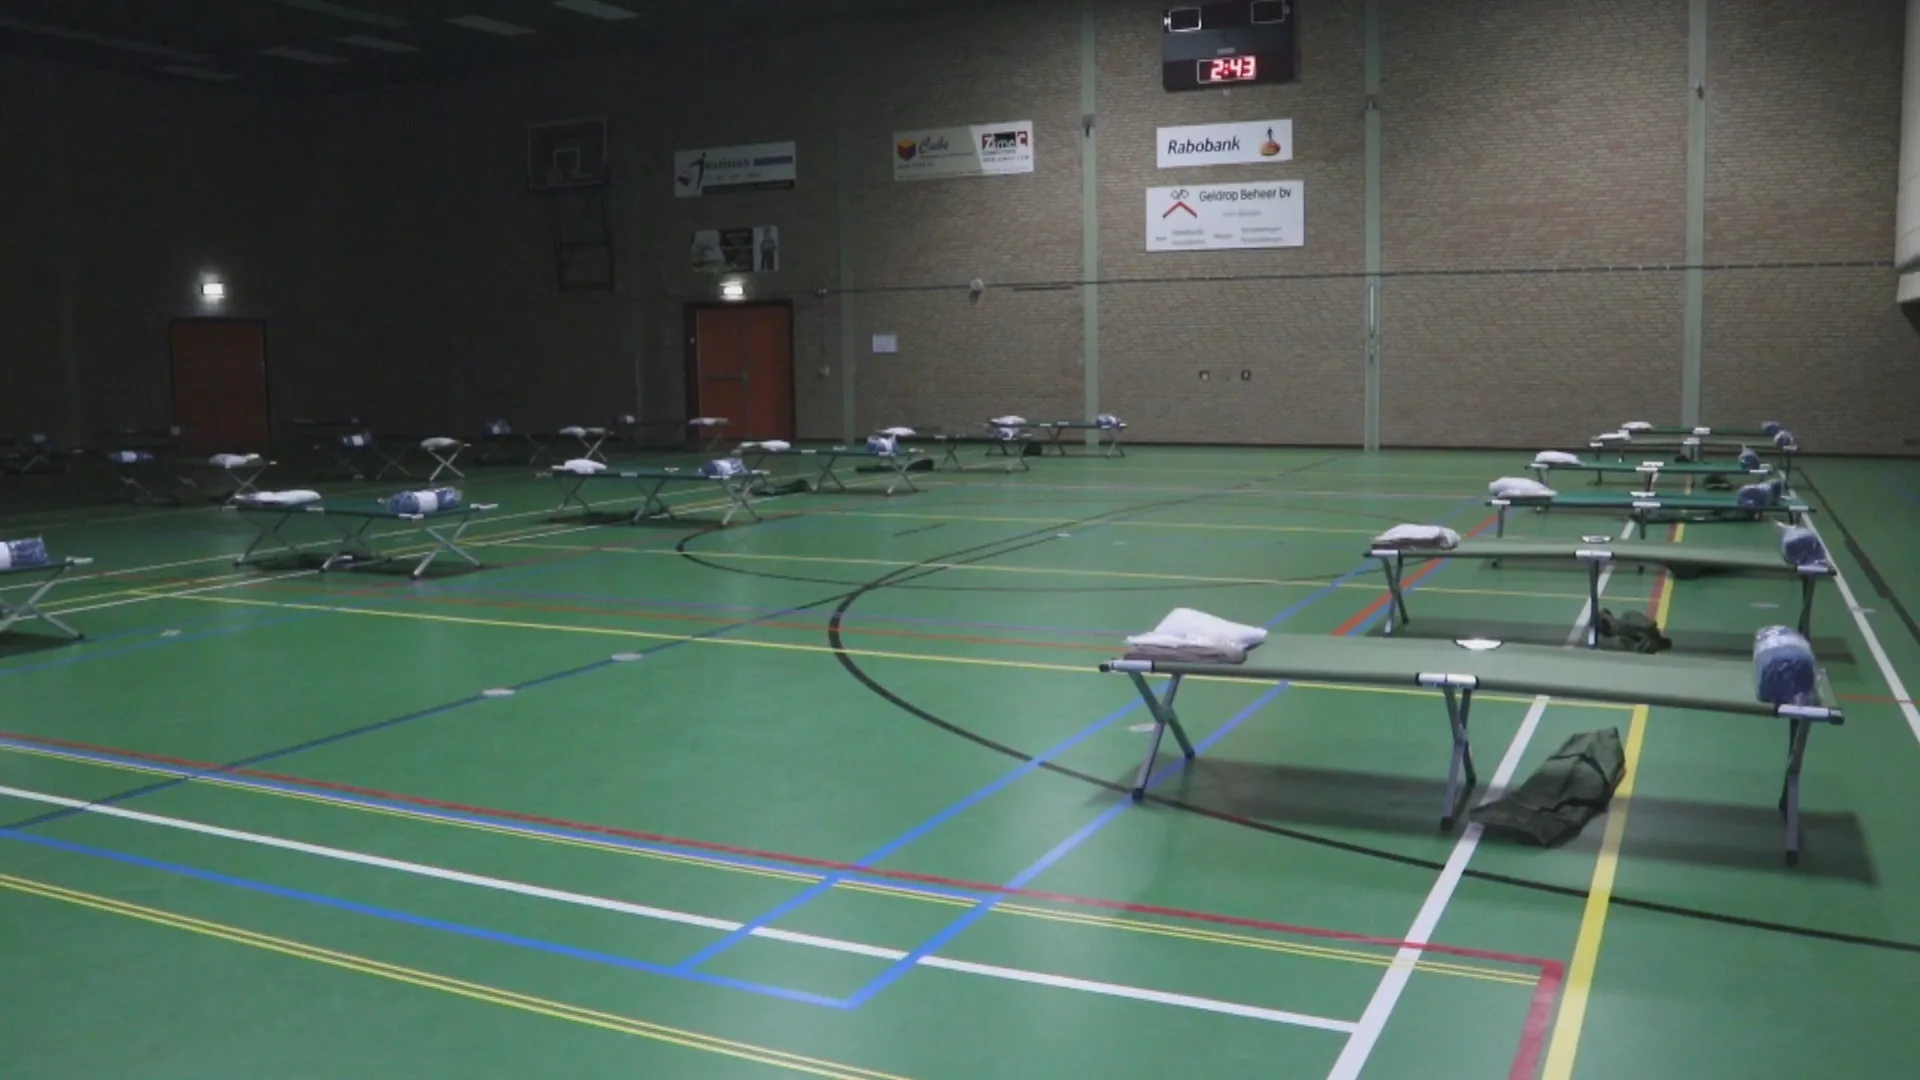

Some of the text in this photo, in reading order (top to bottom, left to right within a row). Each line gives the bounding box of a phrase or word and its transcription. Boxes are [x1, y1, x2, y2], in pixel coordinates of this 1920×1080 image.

[1210, 56, 1256, 81] 2:43
[1167, 135, 1241, 155] Rabobank
[1199, 186, 1292, 203] Geldrop Beheer bv
